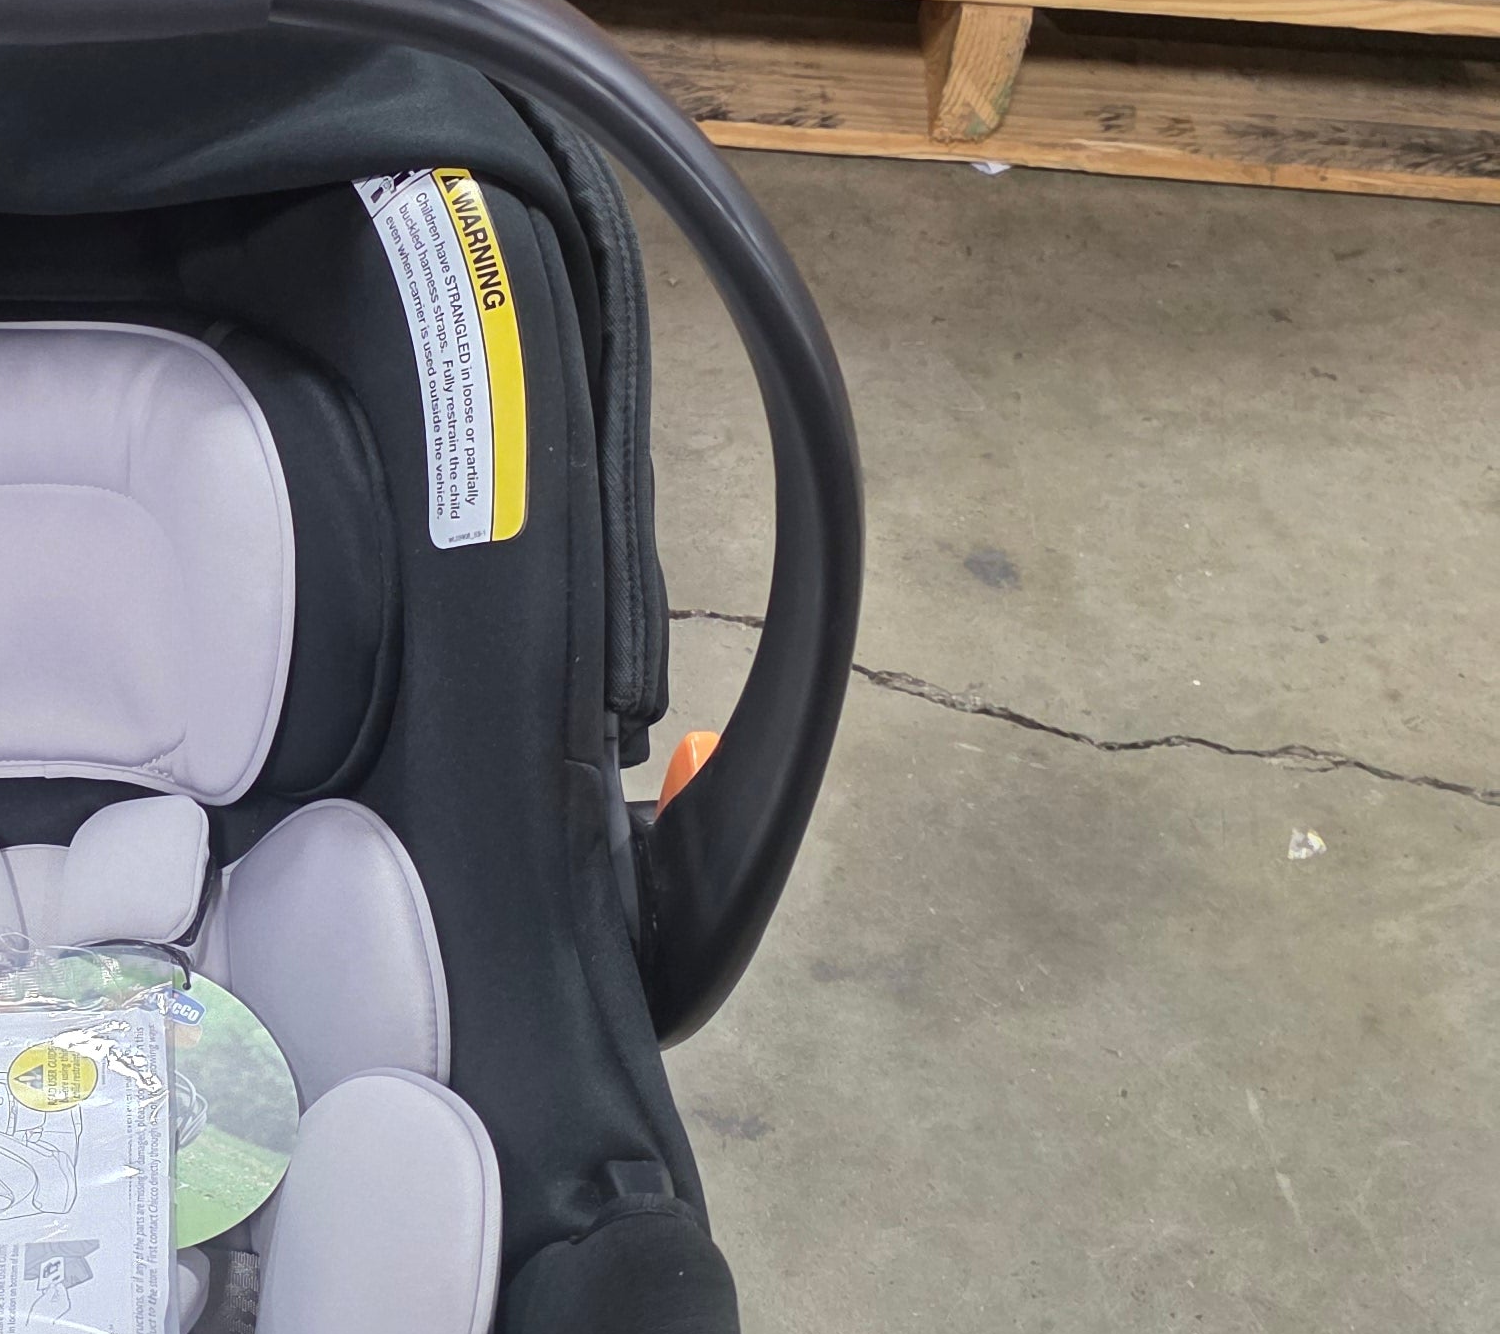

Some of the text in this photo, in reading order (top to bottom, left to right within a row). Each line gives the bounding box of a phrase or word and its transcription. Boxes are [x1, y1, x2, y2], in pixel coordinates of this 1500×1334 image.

[452, 191, 505, 311] WARNING
[416, 193, 479, 505] Children have STRANGLED in loose or partially
[386, 216, 445, 520] even when carrier is used outside the vehicle.
[399, 203, 460, 519] buckled harness straps. Fully restrain the child
[135, 1028, 144, 1042] this
[48, 1070, 57, 1086] USER
[60, 1063, 70, 1080] using
[136, 1089, 144, 1100] do
[148, 1128, 161, 1157] through
[148, 1158, 161, 1186] directly
[137, 1176, 147, 1202] missing
[137, 1204, 145, 1215] are
[148, 1187, 158, 1213] Chicco
[135, 1216, 147, 1236] parts
[149, 1214, 158, 1244] contact
[134, 1237, 144, 1250] the
[148, 1246, 157, 1264] First
[9, 1265, 18, 1287] bottom
[10, 1289, 17, 1297] on
[148, 1289, 158, 1305] the
[7, 1298, 16, 1325] location
[148, 1307, 156, 1317] to
